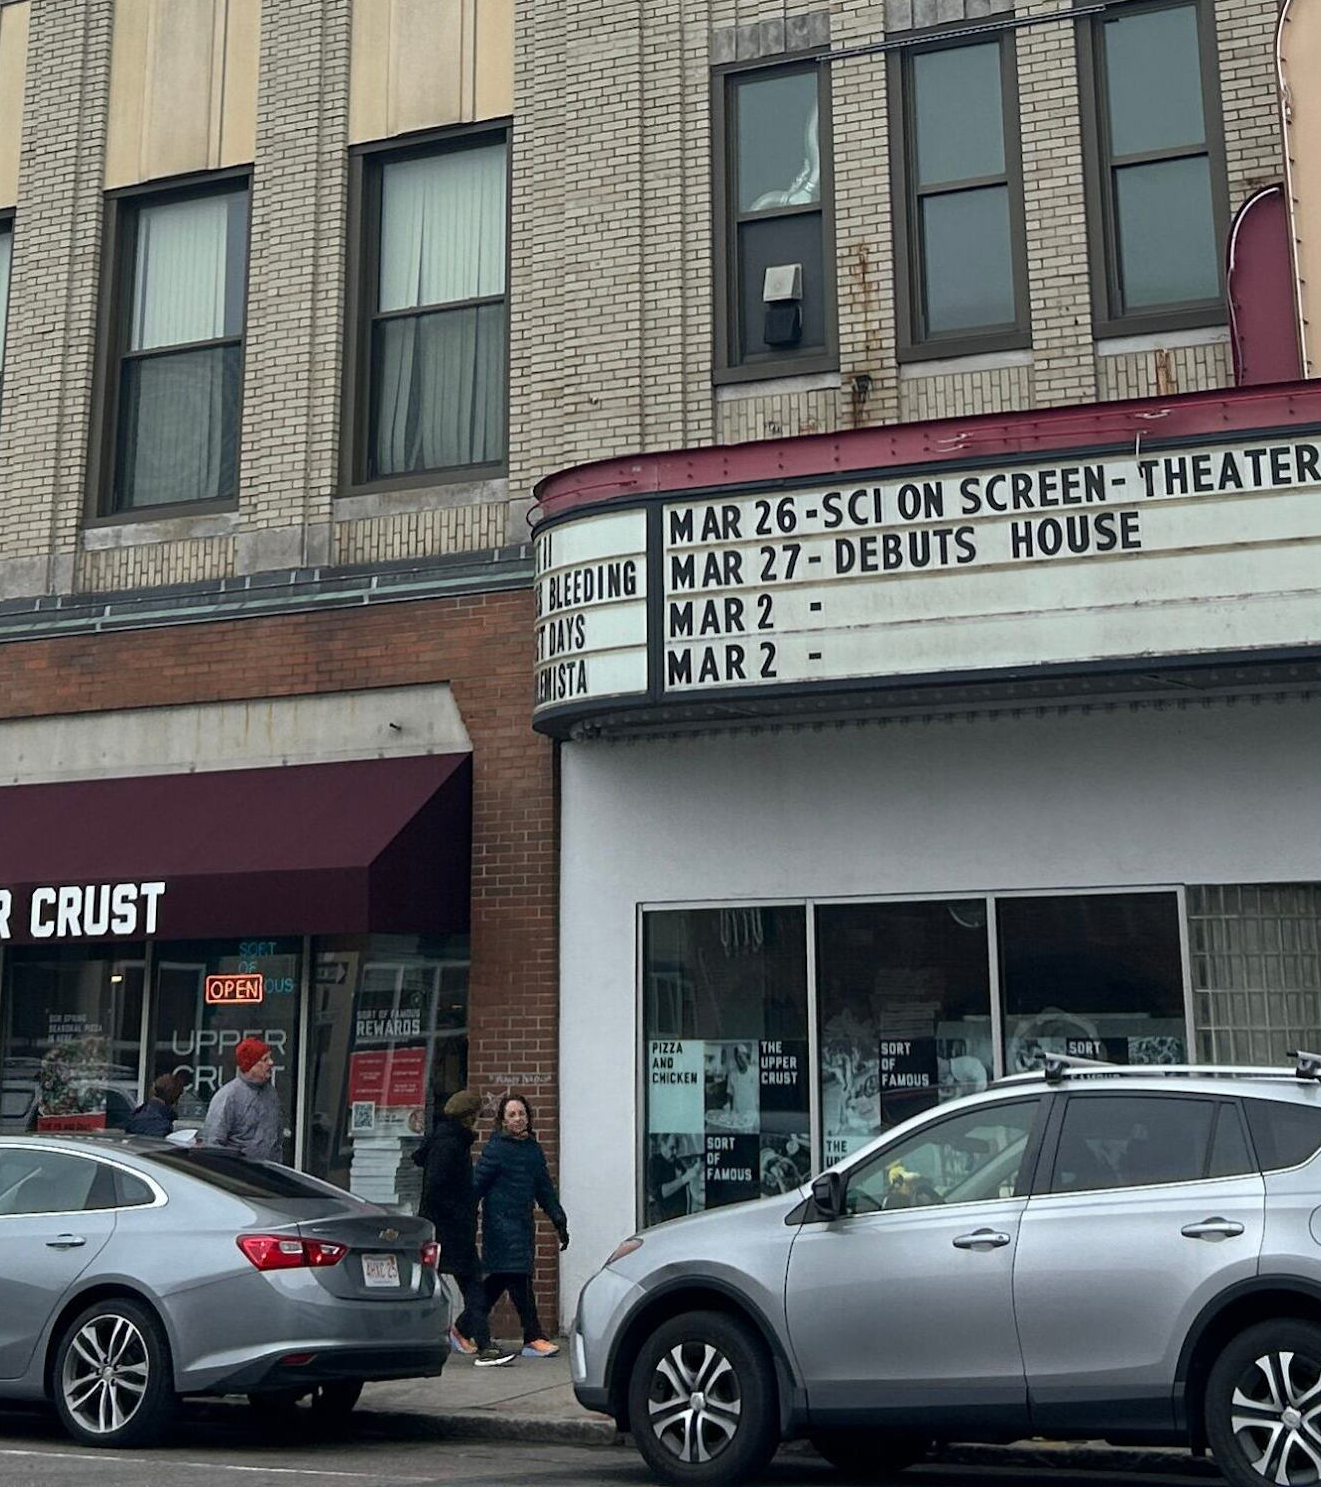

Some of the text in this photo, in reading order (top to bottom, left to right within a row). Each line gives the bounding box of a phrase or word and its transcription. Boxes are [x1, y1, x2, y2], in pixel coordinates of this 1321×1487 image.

[670, 504, 742, 545] MAR
[897, 481, 945, 522] ON
[671, 550, 745, 591] MAR
[835, 526, 977, 575] DEBUTS
[1010, 511, 1142, 560] HOUSE
[549, 560, 637, 612] BLEEDING
[670, 596, 745, 638] MAR
[757, 593, 775, 630] 2
[549, 614, 586, 657] DAYS
[668, 643, 748, 687] MAR
[760, 642, 778, 678] 2
[29, 881, 167, 939] CRUST
[209, 979, 259, 1000] OPEN
[357, 1019, 421, 1036] REWARDS
[652, 1042, 684, 1054] PIZZA
[761, 1041, 783, 1054] THE
[881, 1041, 912, 1054] SORT
[1069, 1040, 1102, 1054] SORT
[652, 1057, 674, 1069] AND
[761, 1056, 798, 1070] UPPER
[881, 1057, 896, 1071] OF
[652, 1072, 698, 1085] CHICKEN
[761, 1071, 799, 1085] CRUST
[881, 1073, 930, 1087] FAMOUS
[706, 1136, 736, 1150] SORT
[826, 1140, 848, 1153] THE
[706, 1152, 720, 1165] OF
[706, 1168, 753, 1181] FAMOUS
